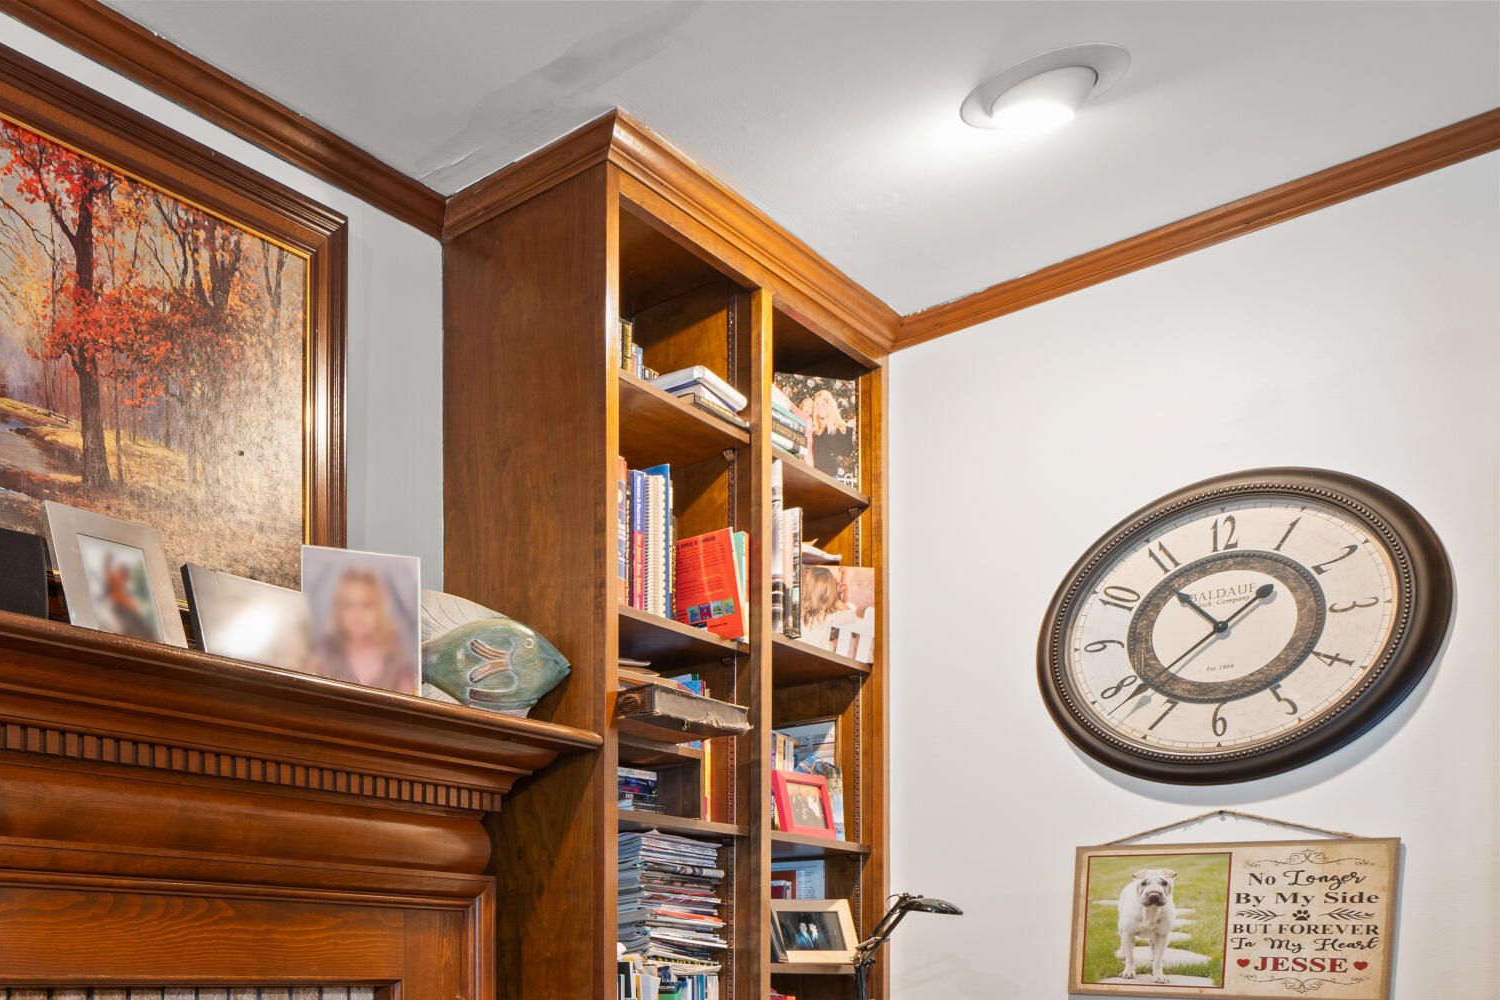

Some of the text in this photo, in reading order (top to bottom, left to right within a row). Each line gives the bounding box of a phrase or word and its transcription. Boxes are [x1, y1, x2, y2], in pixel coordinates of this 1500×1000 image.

[1209, 514, 1239, 554] 12
[1273, 516, 1302, 552] 1
[1148, 540, 1181, 575] 11
[1313, 544, 1359, 575] 2
[1100, 584, 1141, 613] 10
[1190, 583, 1257, 601] BALDAUF
[1216, 595, 1251, 605] Company
[1328, 596, 1379, 615] 3
[1083, 638, 1125, 654] 9
[1313, 649, 1356, 671] 4
[1100, 674, 1138, 701] 8
[1268, 682, 1299, 716] 5
[1148, 698, 1179, 732] 7
[1212, 702, 1229, 738] 6
[1248, 870, 1367, 890] No Longer
[1235, 891, 1380, 907] By My Side
[1232, 924, 1380, 935] BUT FOREVER
[1230, 937, 1380, 954] In My Heart
[1254, 956, 1349, 974] JESSE
